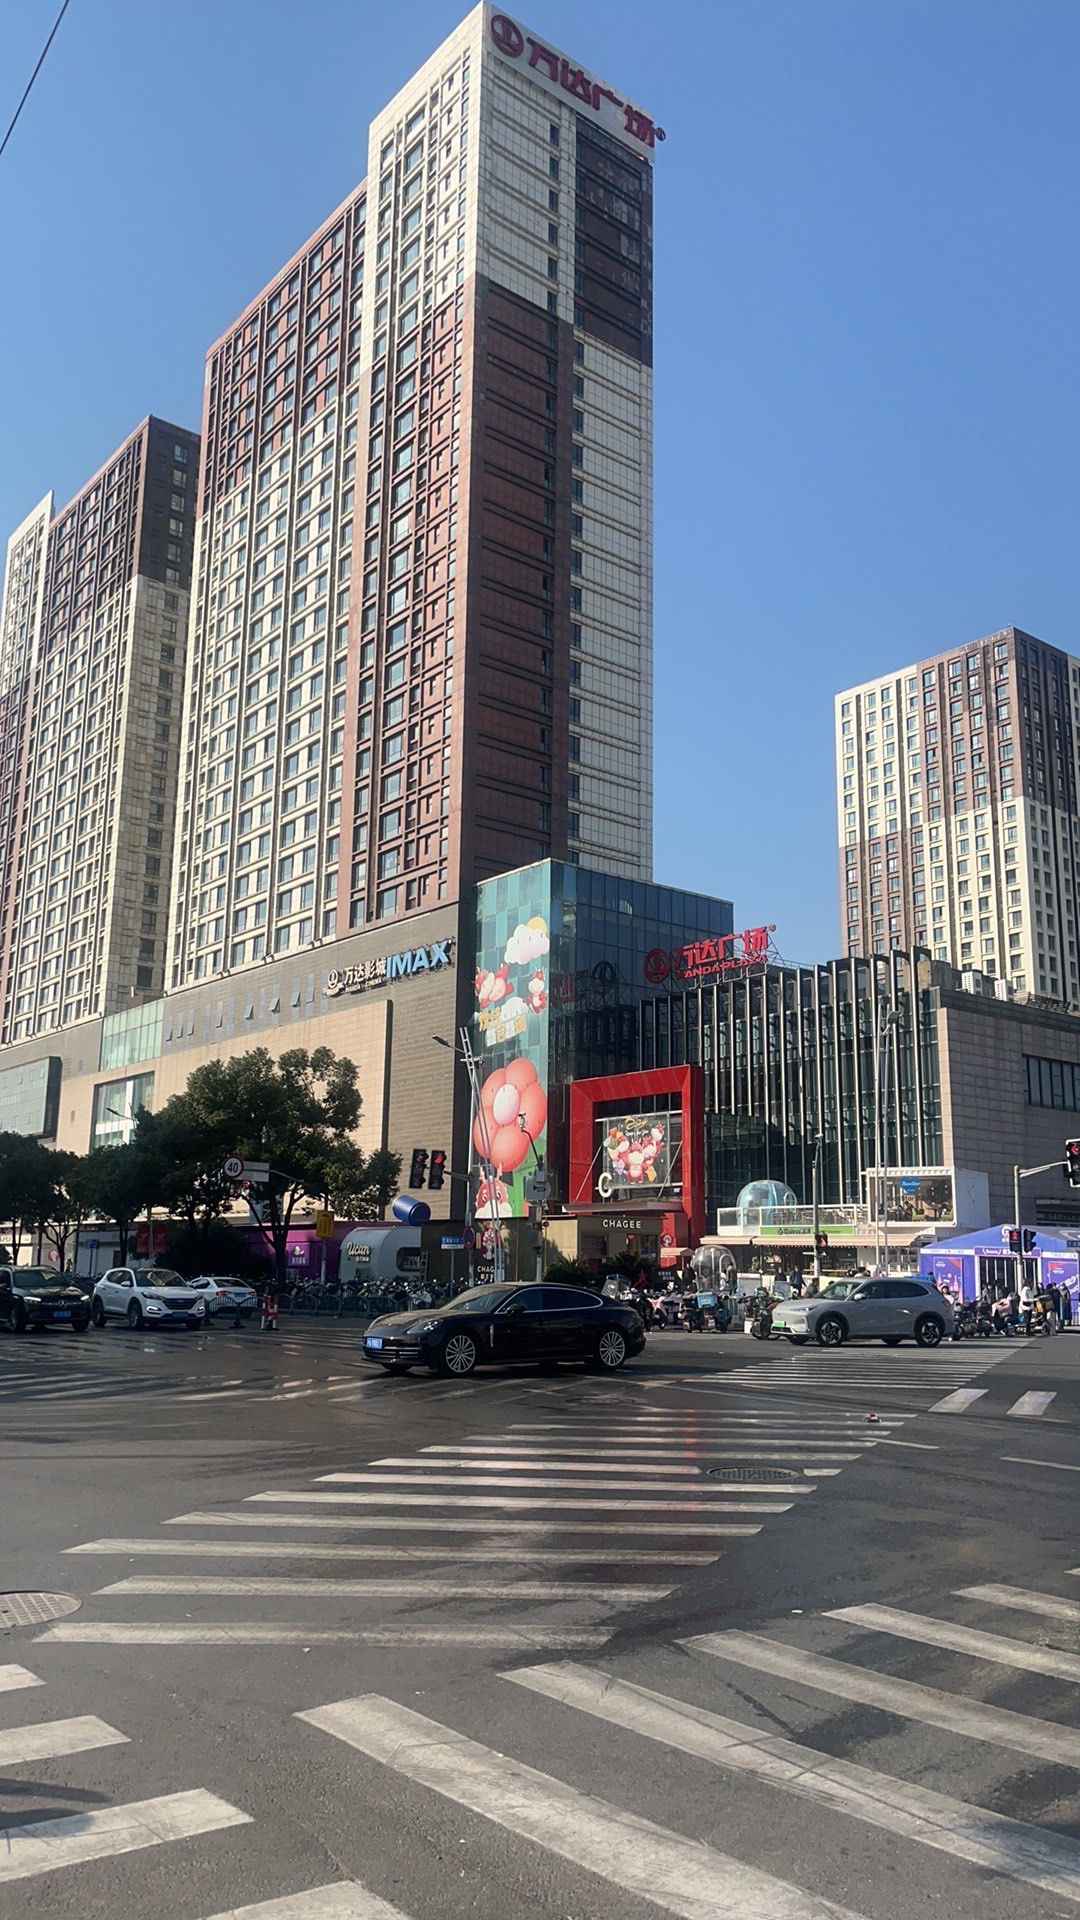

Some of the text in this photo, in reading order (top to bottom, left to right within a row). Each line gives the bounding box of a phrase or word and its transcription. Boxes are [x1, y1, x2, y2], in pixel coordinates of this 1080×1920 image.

[526, 36, 655, 149] 万达广场
[386, 940, 449, 979] IMAX
[674, 926, 769, 969] 万达广场
[344, 957, 386, 985] 万达影城
[227, 1162, 239, 1173] 40
[602, 1219, 642, 1229] CHAGEE
